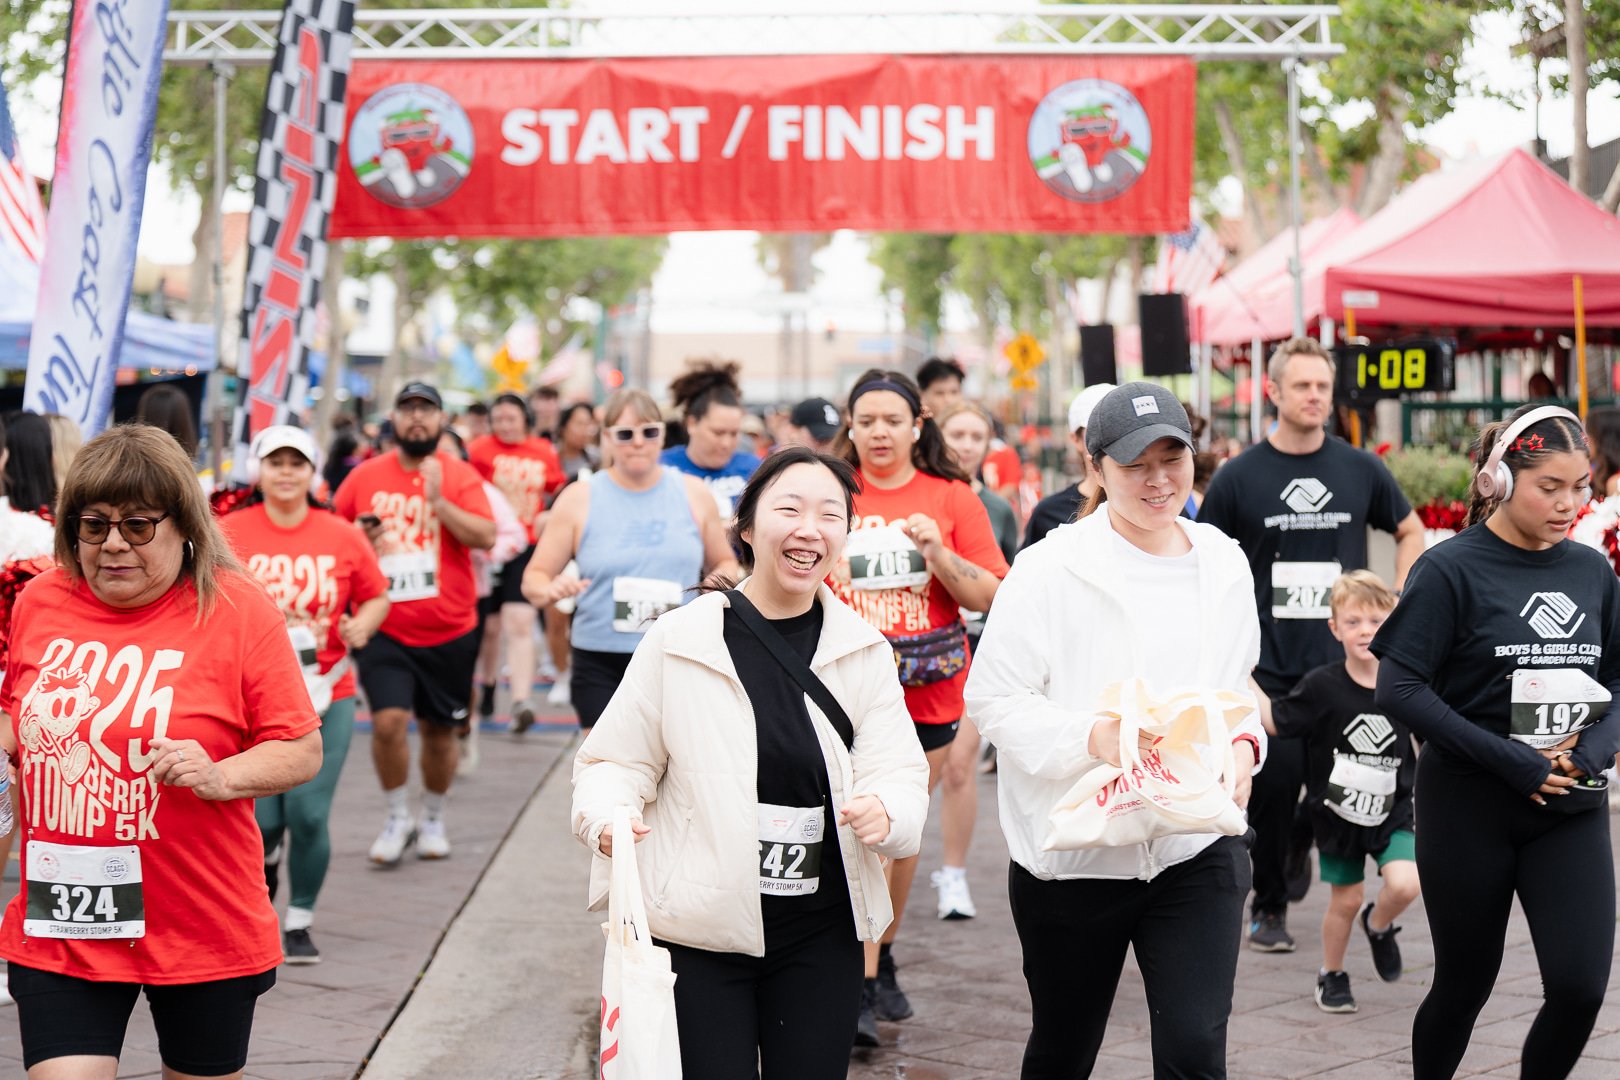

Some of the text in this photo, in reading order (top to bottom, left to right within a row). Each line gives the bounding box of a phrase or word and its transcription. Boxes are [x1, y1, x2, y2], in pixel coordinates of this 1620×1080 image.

[96, 0, 140, 116] ific
[500, 103, 995, 166] START / FINISH
[75, 139, 122, 338] Coast
[864, 551, 912, 577] 706
[1286, 586, 1327, 608] 207
[1495, 644, 1531, 657] BOYS
[1531, 643, 1542, 655] &
[1543, 643, 1578, 655] GIRLS
[1517, 656, 1596, 665] OF GARDEN GROVE
[1534, 702, 1590, 735] 192
[1340, 788, 1386, 816] 208
[115, 792, 161, 841] 5K
[776, 883, 796, 891] STOMP
[796, 883, 803, 891] 5K
[50, 884, 119, 922] 324
[49, 925, 123, 934] STRAWBERRY STOMP 5K
